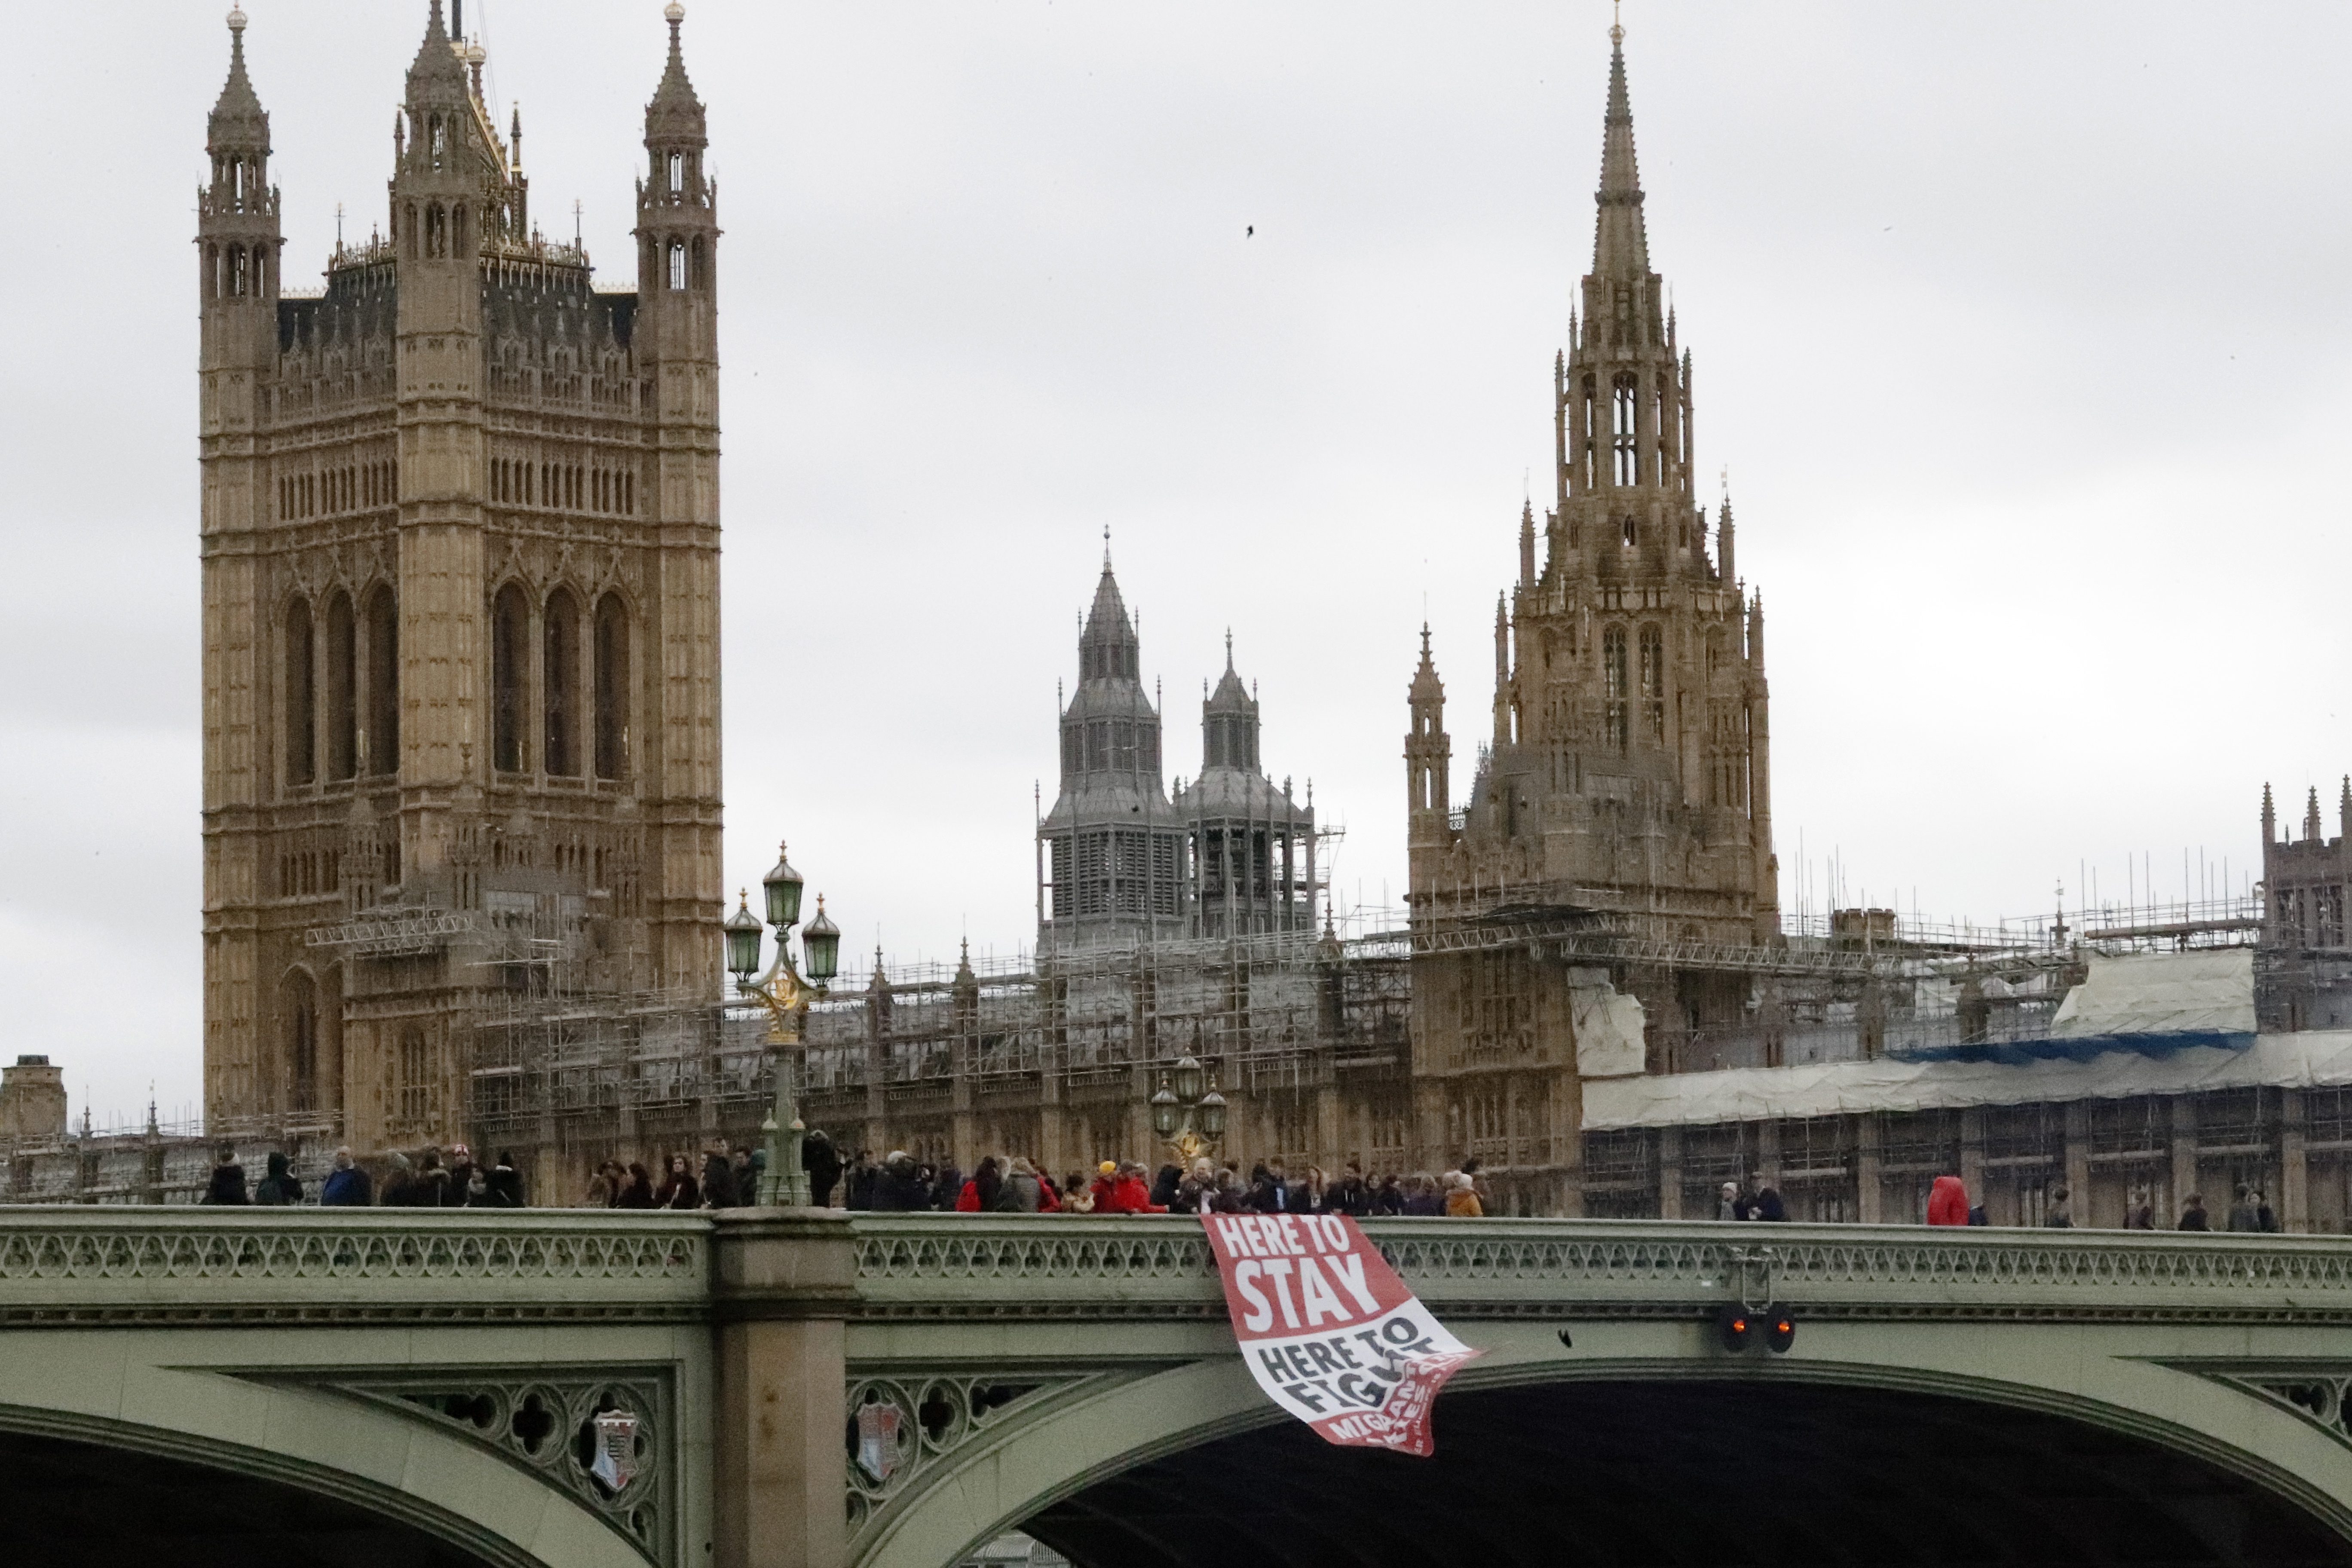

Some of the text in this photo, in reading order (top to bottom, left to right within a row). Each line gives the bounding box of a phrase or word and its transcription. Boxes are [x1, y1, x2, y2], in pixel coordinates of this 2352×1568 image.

[1216, 1215, 1350, 1257] HERE TO
[1235, 1253, 1381, 1332] STAY
[1258, 1317, 1418, 1383] HERE TO
[1283, 1337, 1444, 1413] FIGHT
